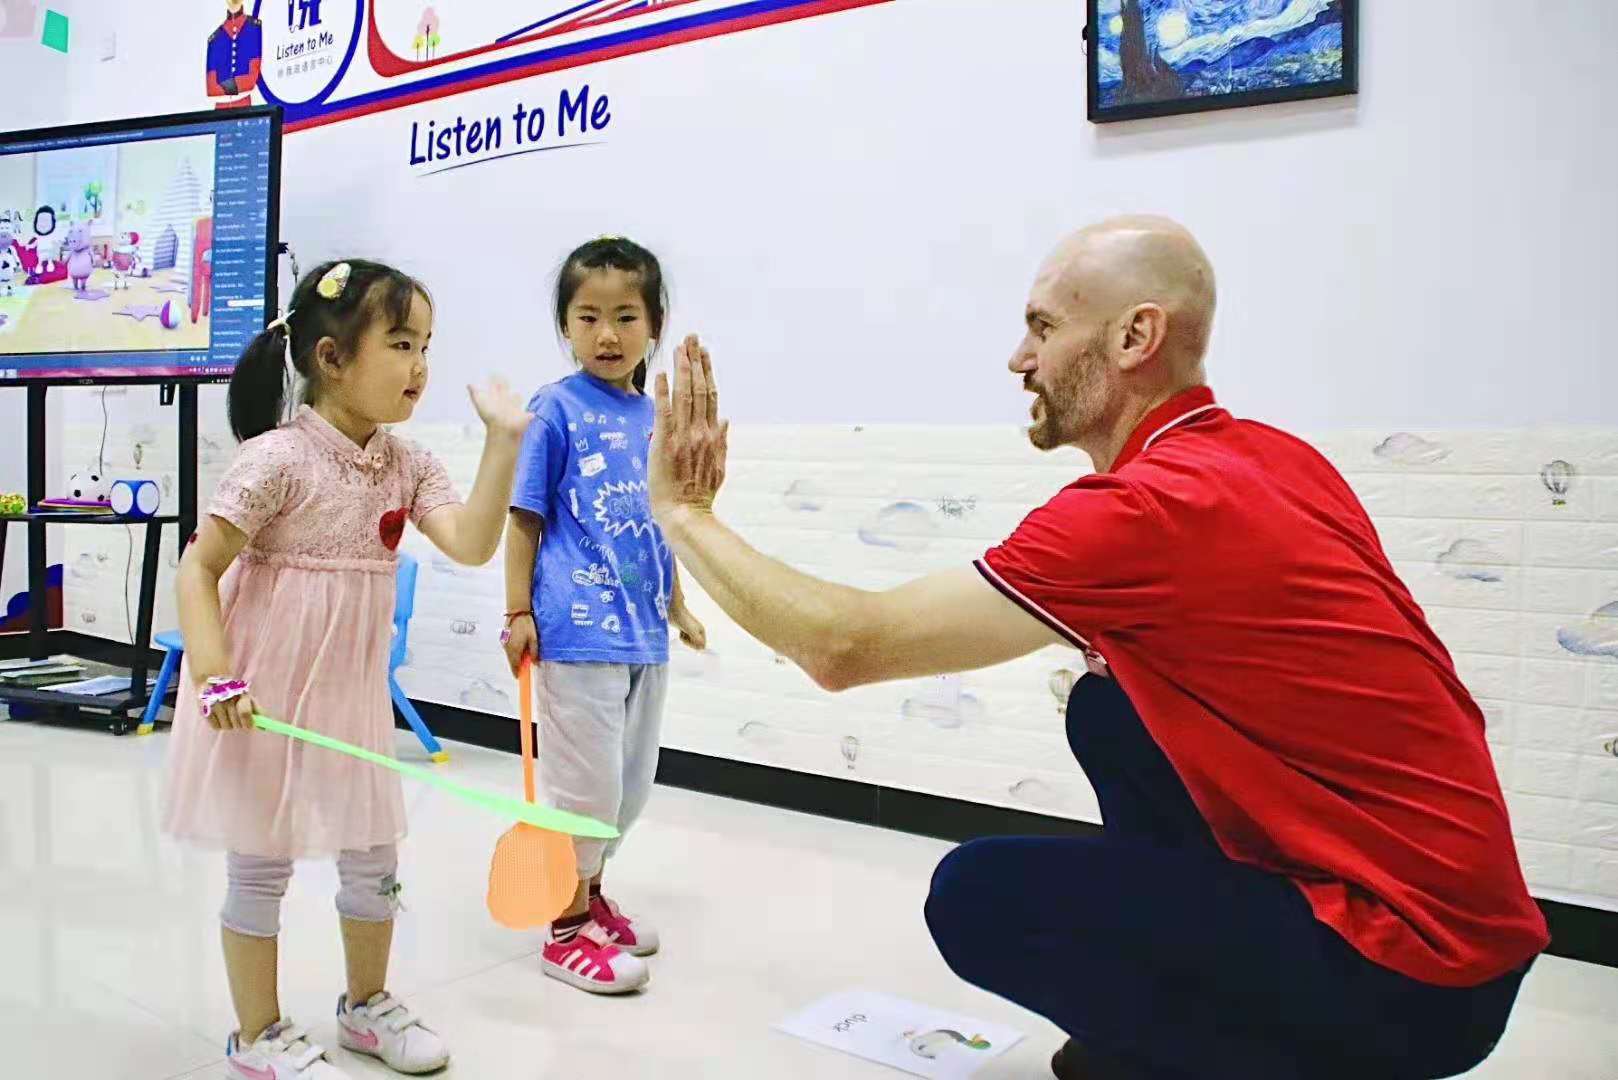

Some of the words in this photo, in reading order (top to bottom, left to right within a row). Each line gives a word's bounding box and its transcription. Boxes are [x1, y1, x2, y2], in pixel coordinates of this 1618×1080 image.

[276, 43, 304, 60] Listen
[307, 38, 316, 51] to
[318, 30, 334, 48] Me
[409, 116, 501, 165] Listen
[512, 103, 545, 145] to
[558, 84, 611, 137] Me
[832, 1013, 868, 1032] duck
